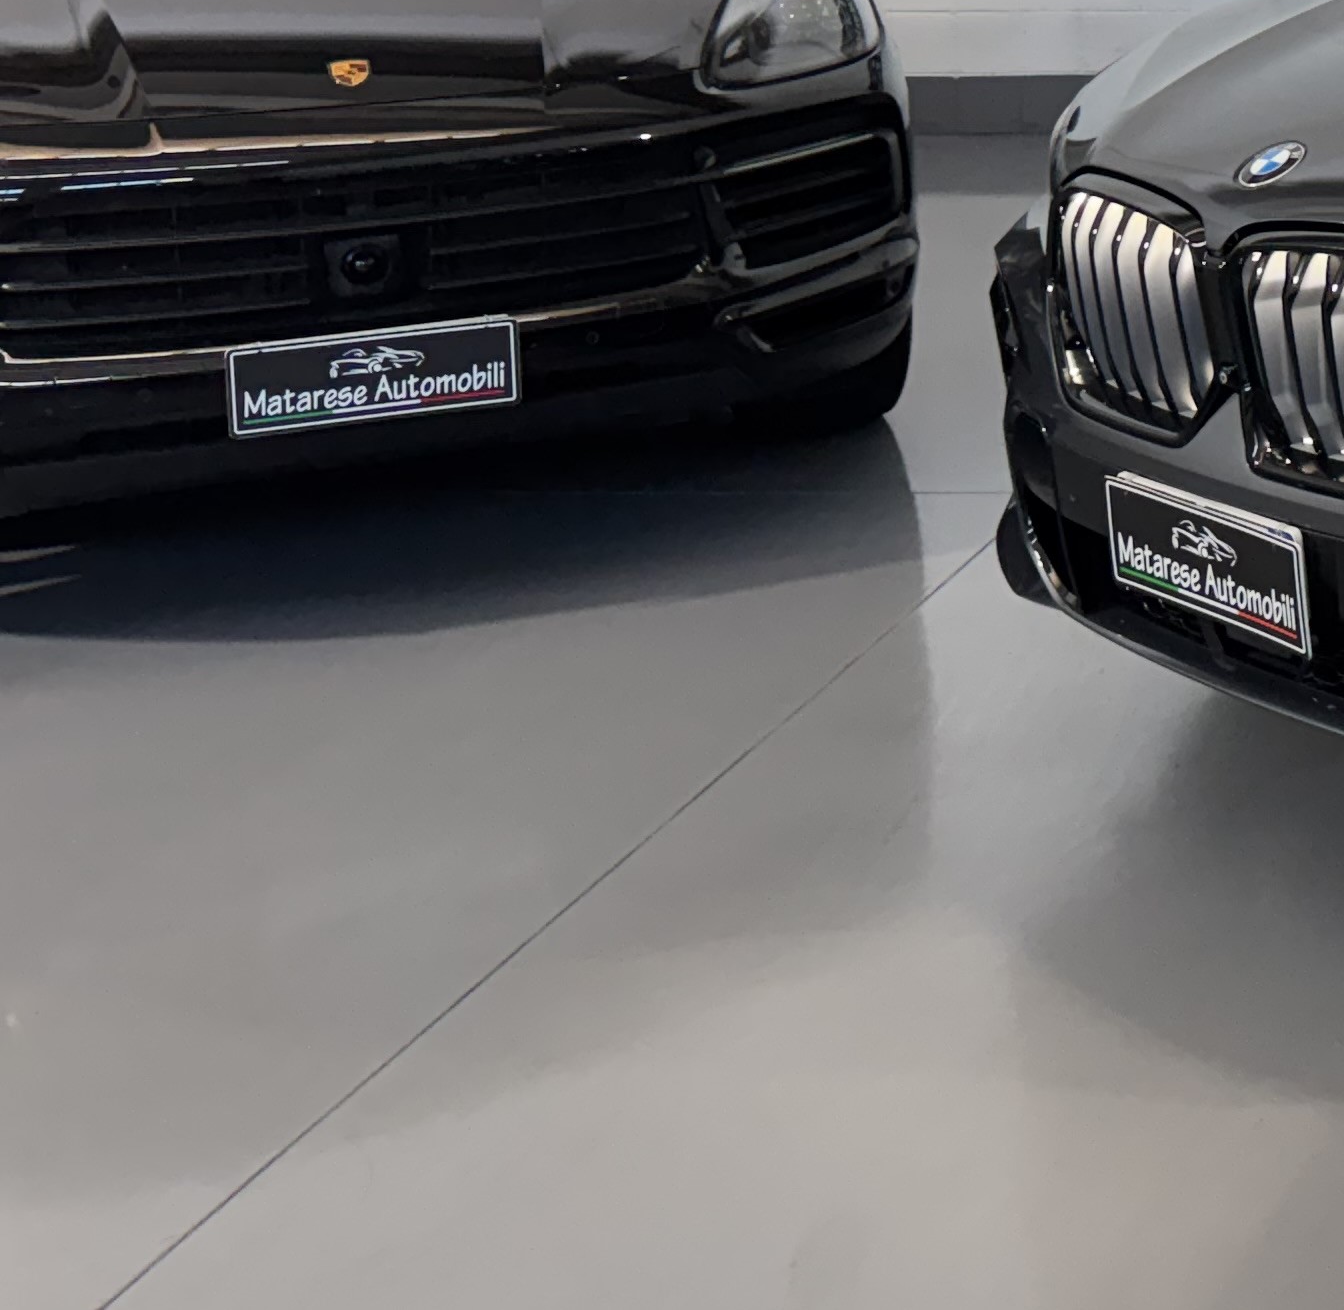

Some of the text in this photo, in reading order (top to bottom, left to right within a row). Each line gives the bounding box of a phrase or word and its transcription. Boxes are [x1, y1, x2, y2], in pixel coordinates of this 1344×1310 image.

[243, 361, 505, 419] Matarese Automobili
[1117, 531, 1297, 631] Matarese Automobili
